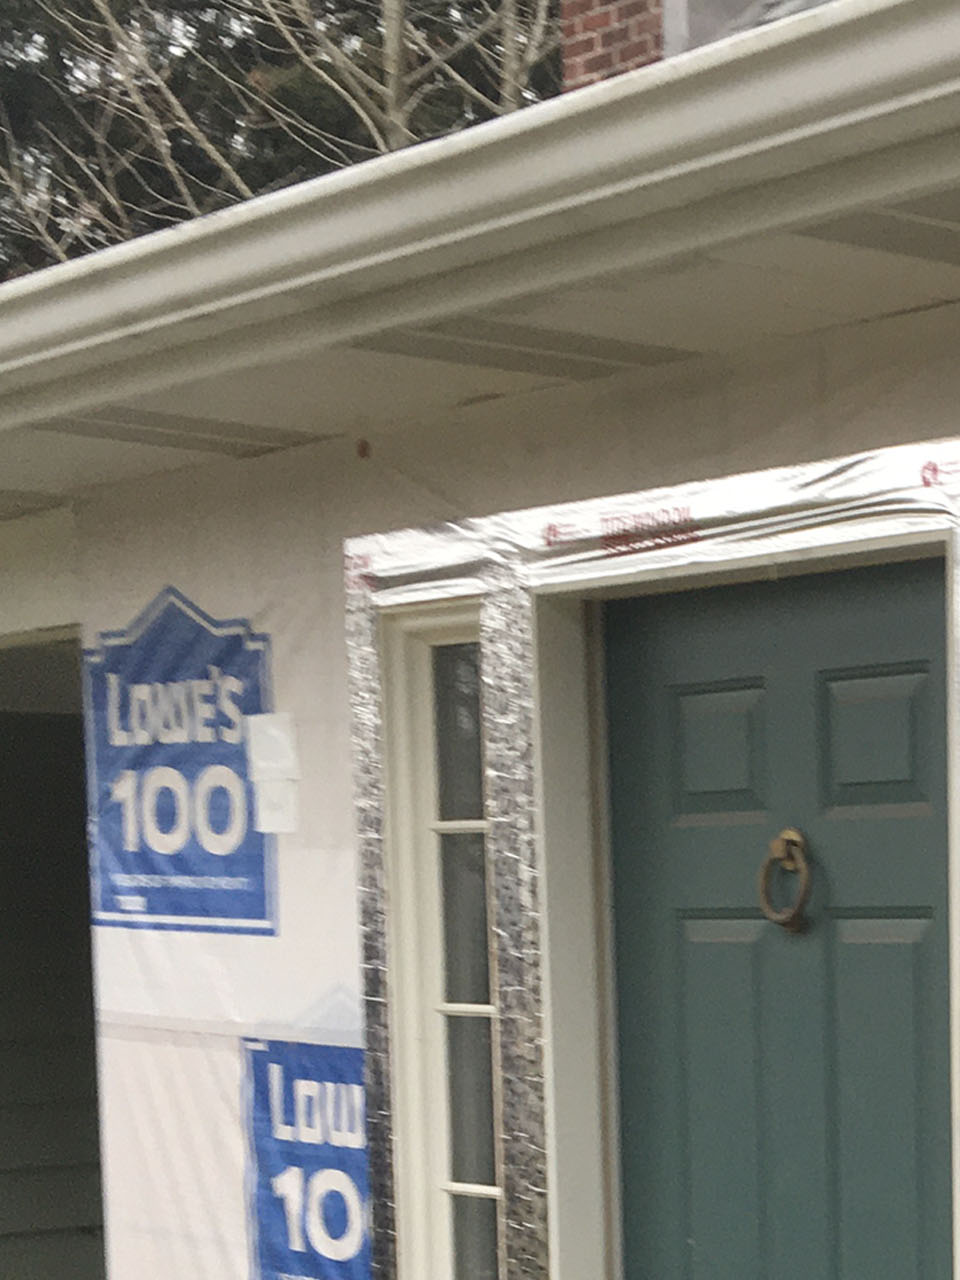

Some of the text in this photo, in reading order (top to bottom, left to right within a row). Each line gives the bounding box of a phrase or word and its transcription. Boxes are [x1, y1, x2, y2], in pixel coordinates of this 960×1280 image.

[106, 665, 245, 746] LOWE'S
[109, 764, 248, 856] 100
[271, 1165, 373, 1263] 10
